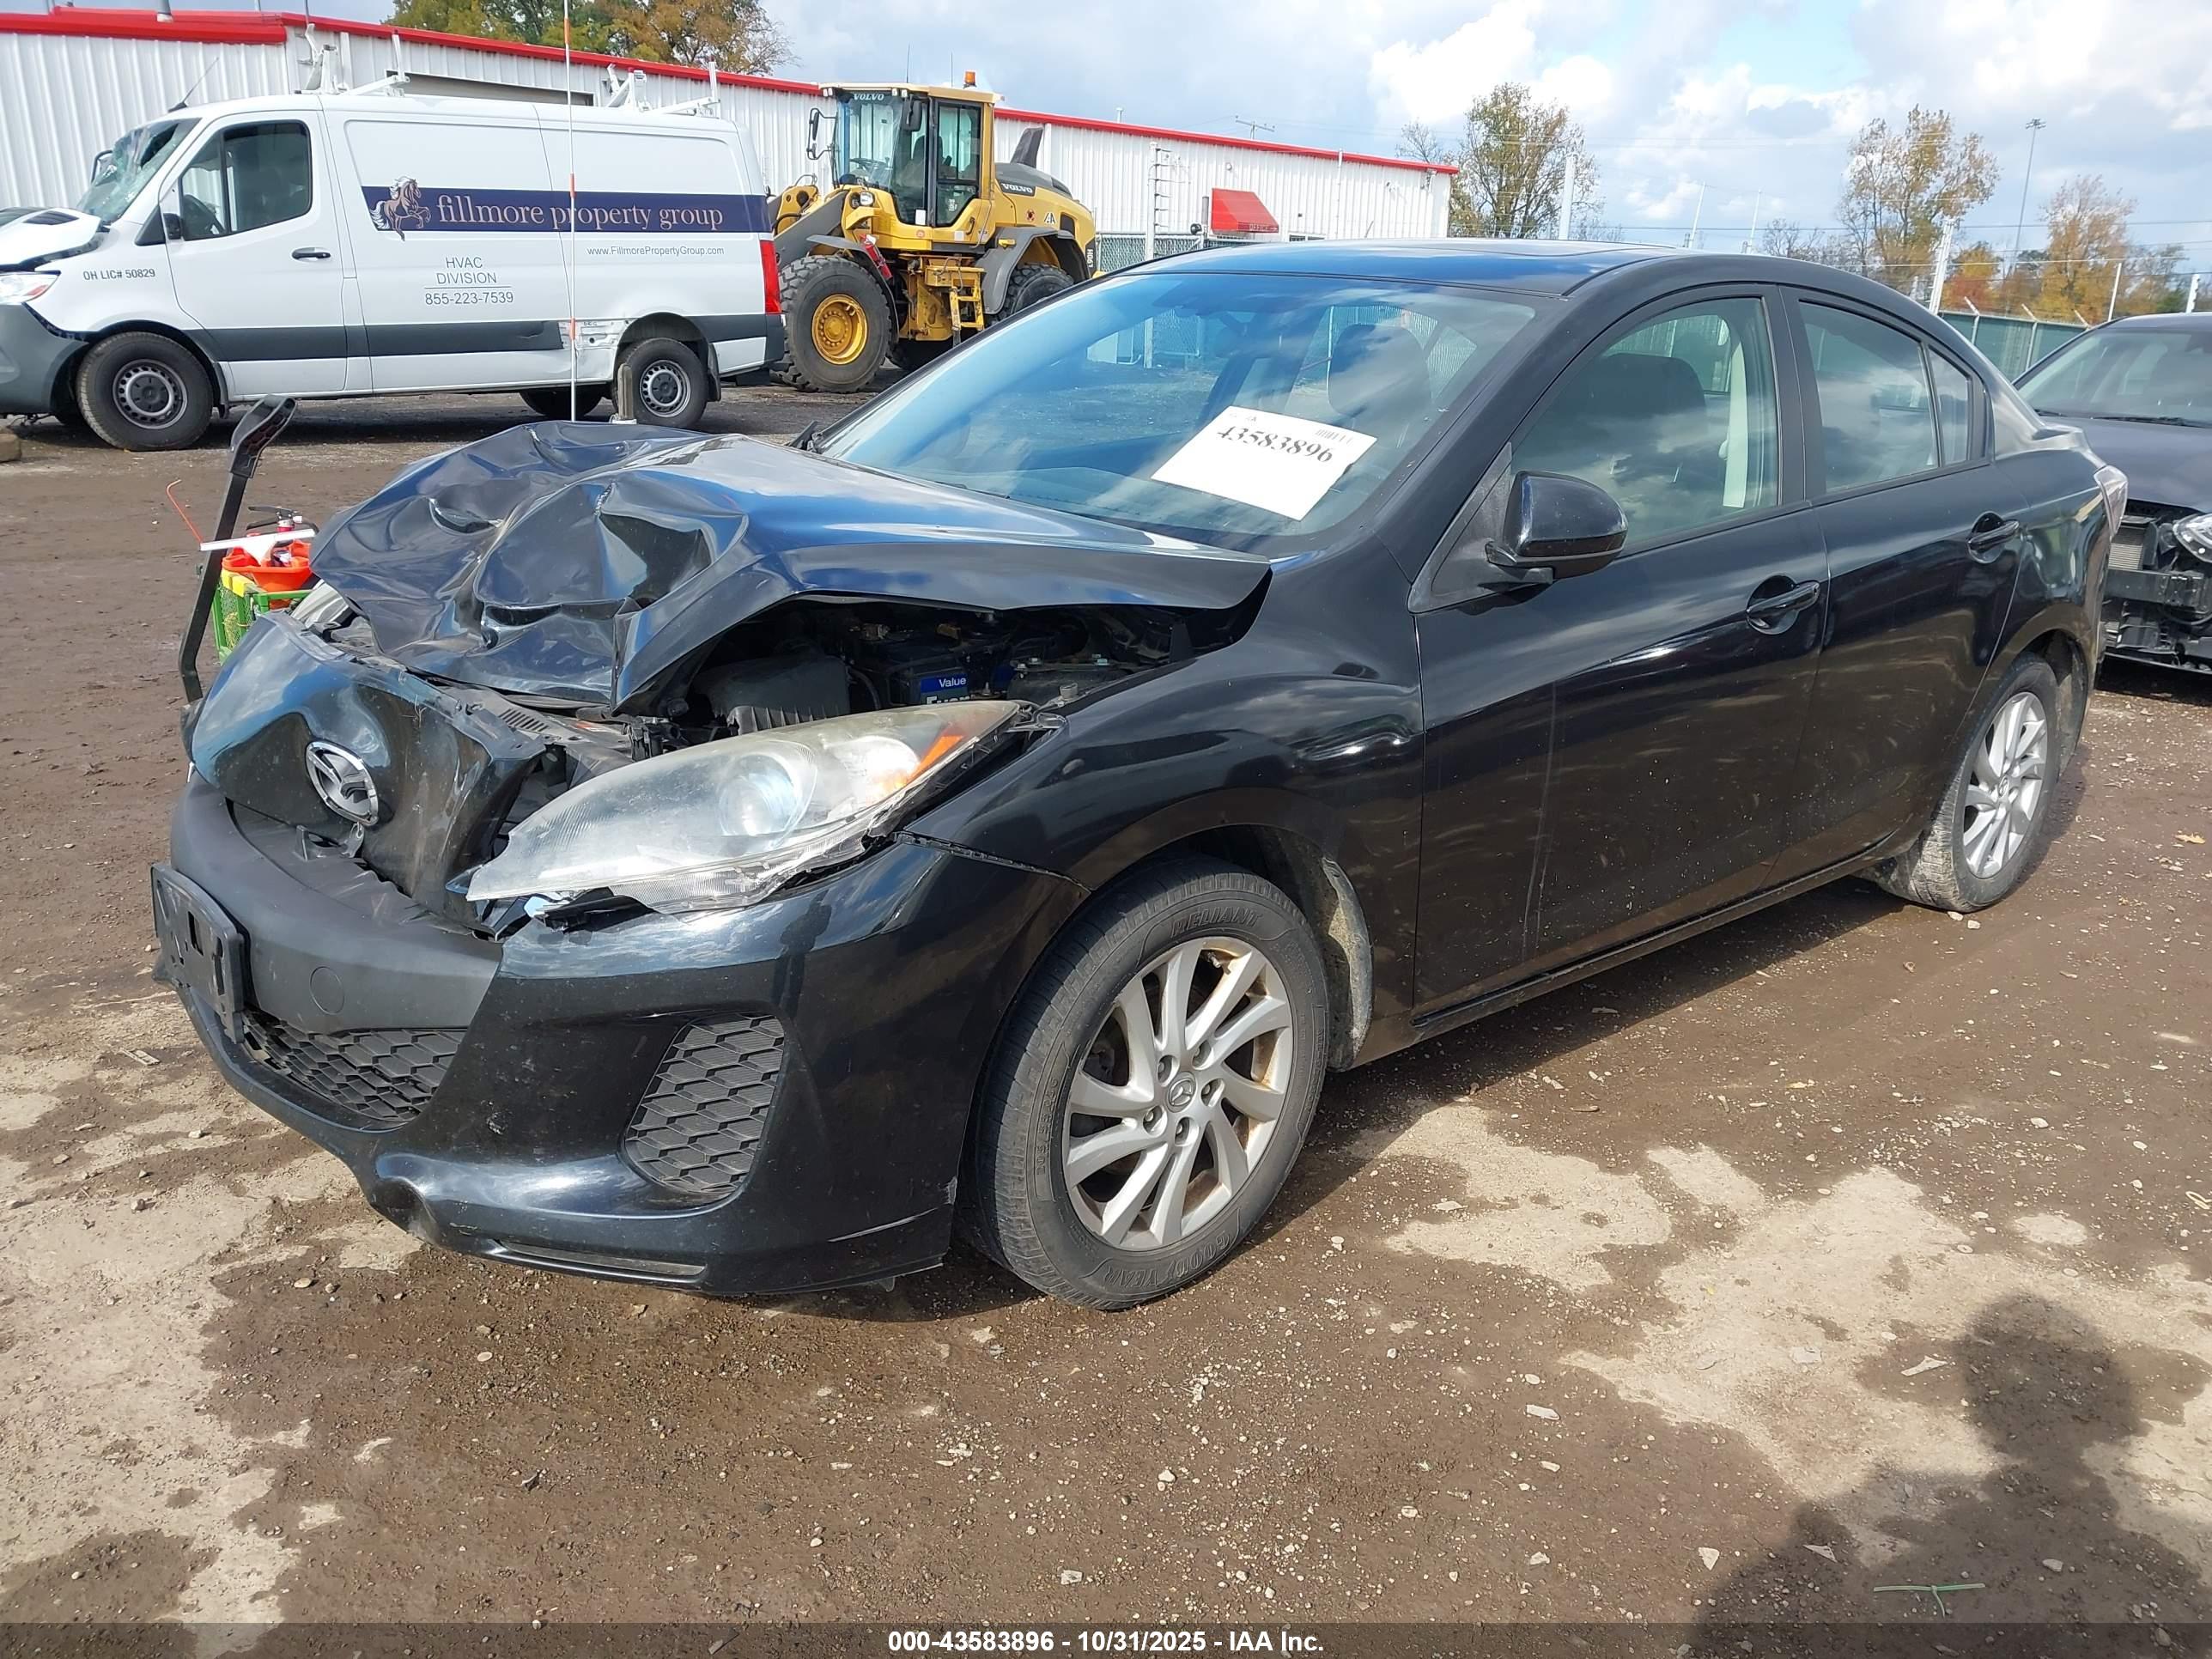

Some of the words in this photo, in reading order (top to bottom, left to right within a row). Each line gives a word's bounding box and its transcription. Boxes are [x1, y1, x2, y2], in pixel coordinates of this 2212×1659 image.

[1001, 183, 1033, 193] VOLVO
[436, 195, 544, 223] fillmore
[550, 204, 651, 230] property
[659, 208, 723, 230] group
[586, 246, 725, 257] www.FillmorePropertyGroup.com
[446, 257, 483, 269] HVAC
[82, 270, 98, 281] OH
[100, 270, 122, 280] LIC#
[125, 268, 155, 279] 50829
[436, 272, 497, 284] DIVISION
[425, 291, 514, 305] 855-223-7539
[1217, 426, 1333, 462] 43583896
[939, 678, 967, 688] Value
